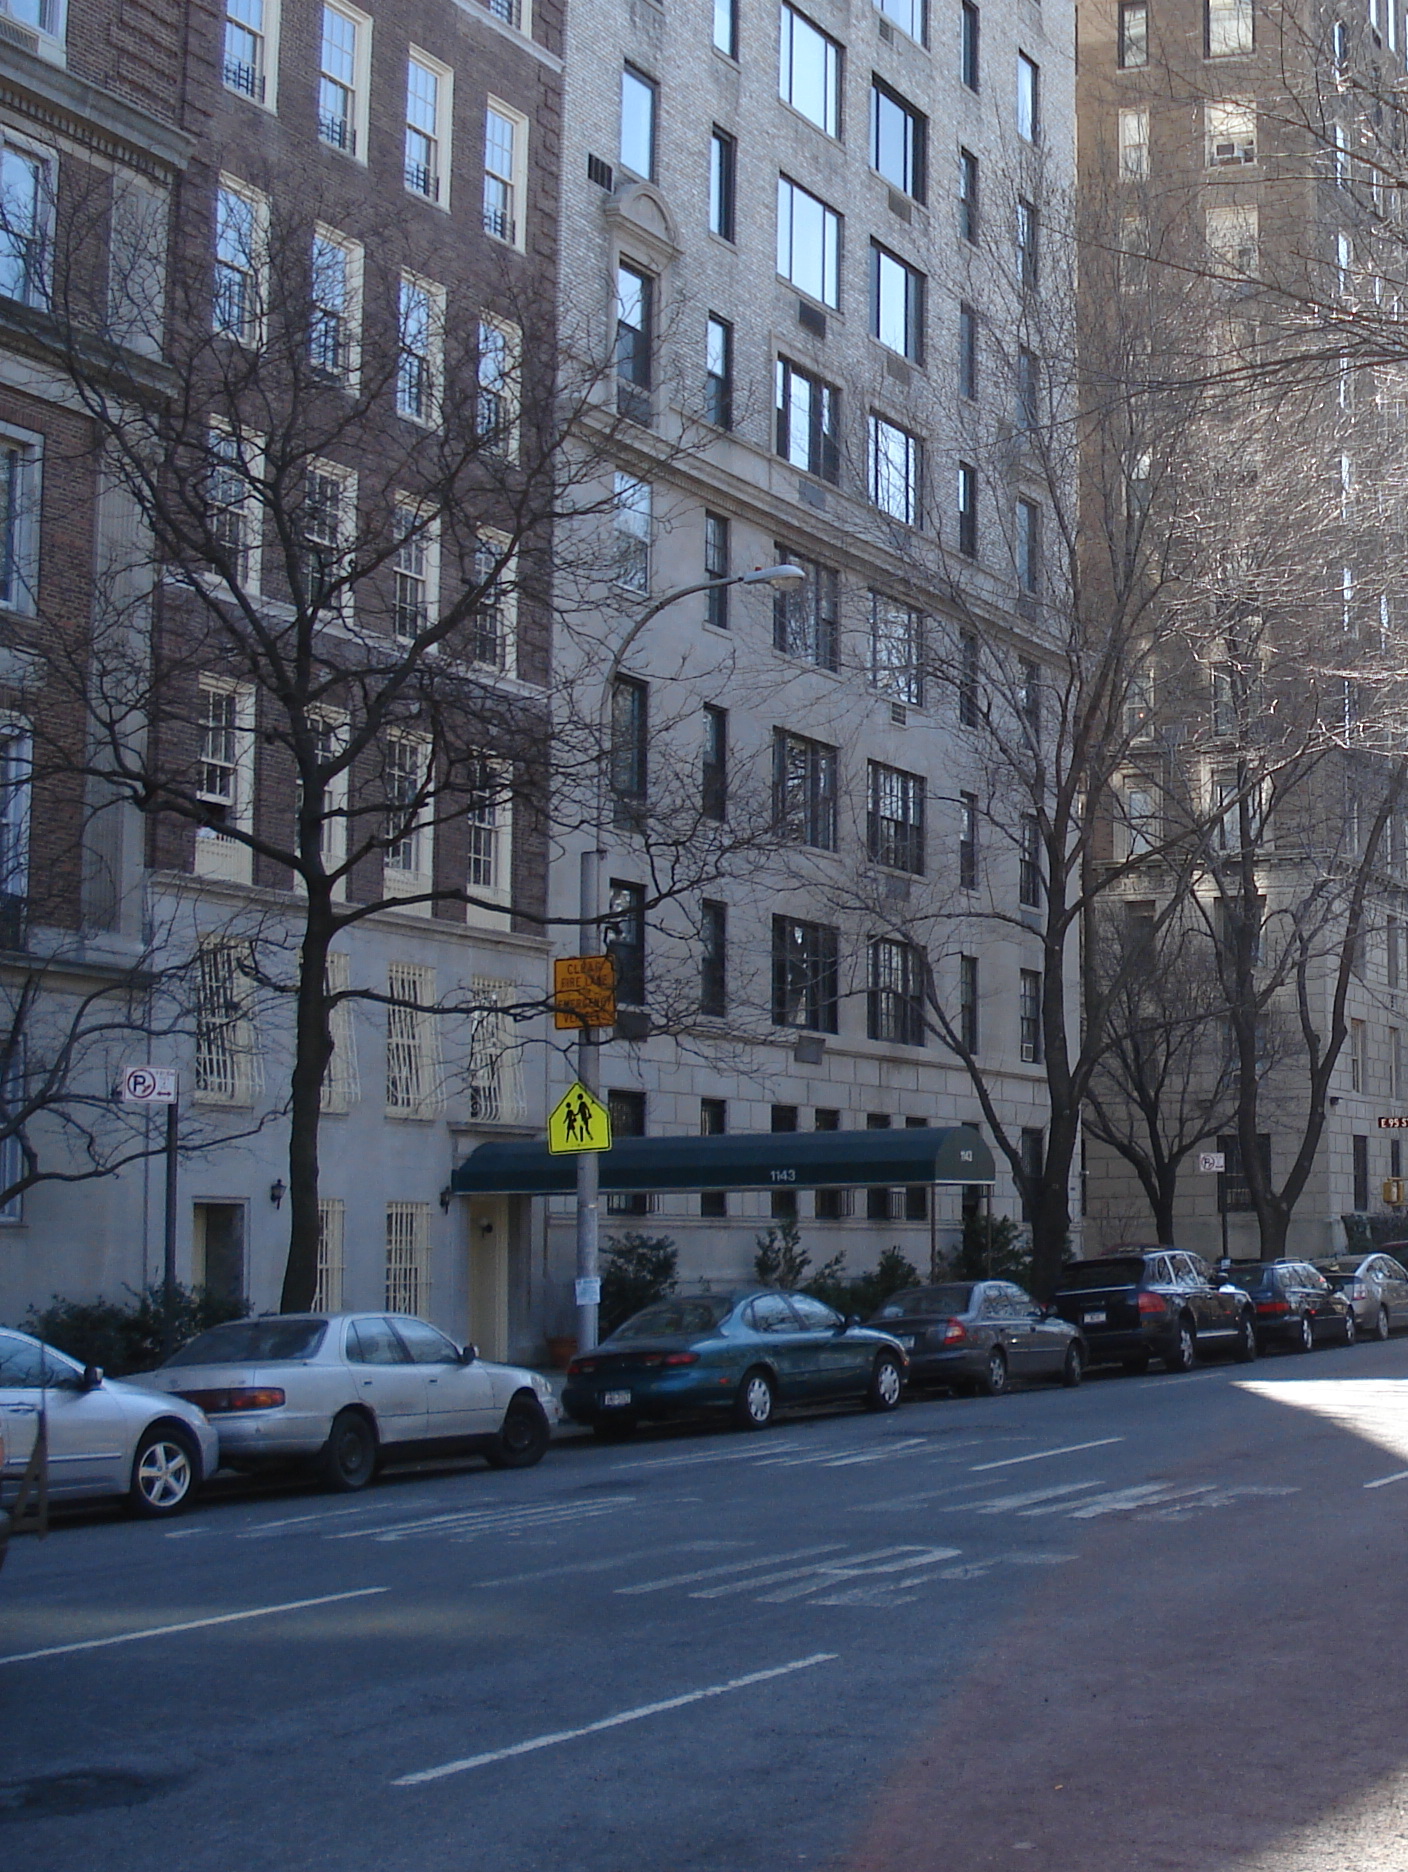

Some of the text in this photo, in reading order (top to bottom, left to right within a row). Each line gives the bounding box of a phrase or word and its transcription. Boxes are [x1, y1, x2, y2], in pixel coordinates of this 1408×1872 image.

[1381, 1118, 1387, 1128] E
[1389, 1118, 1400, 1128] 95
[769, 1169, 797, 1182] 1143
